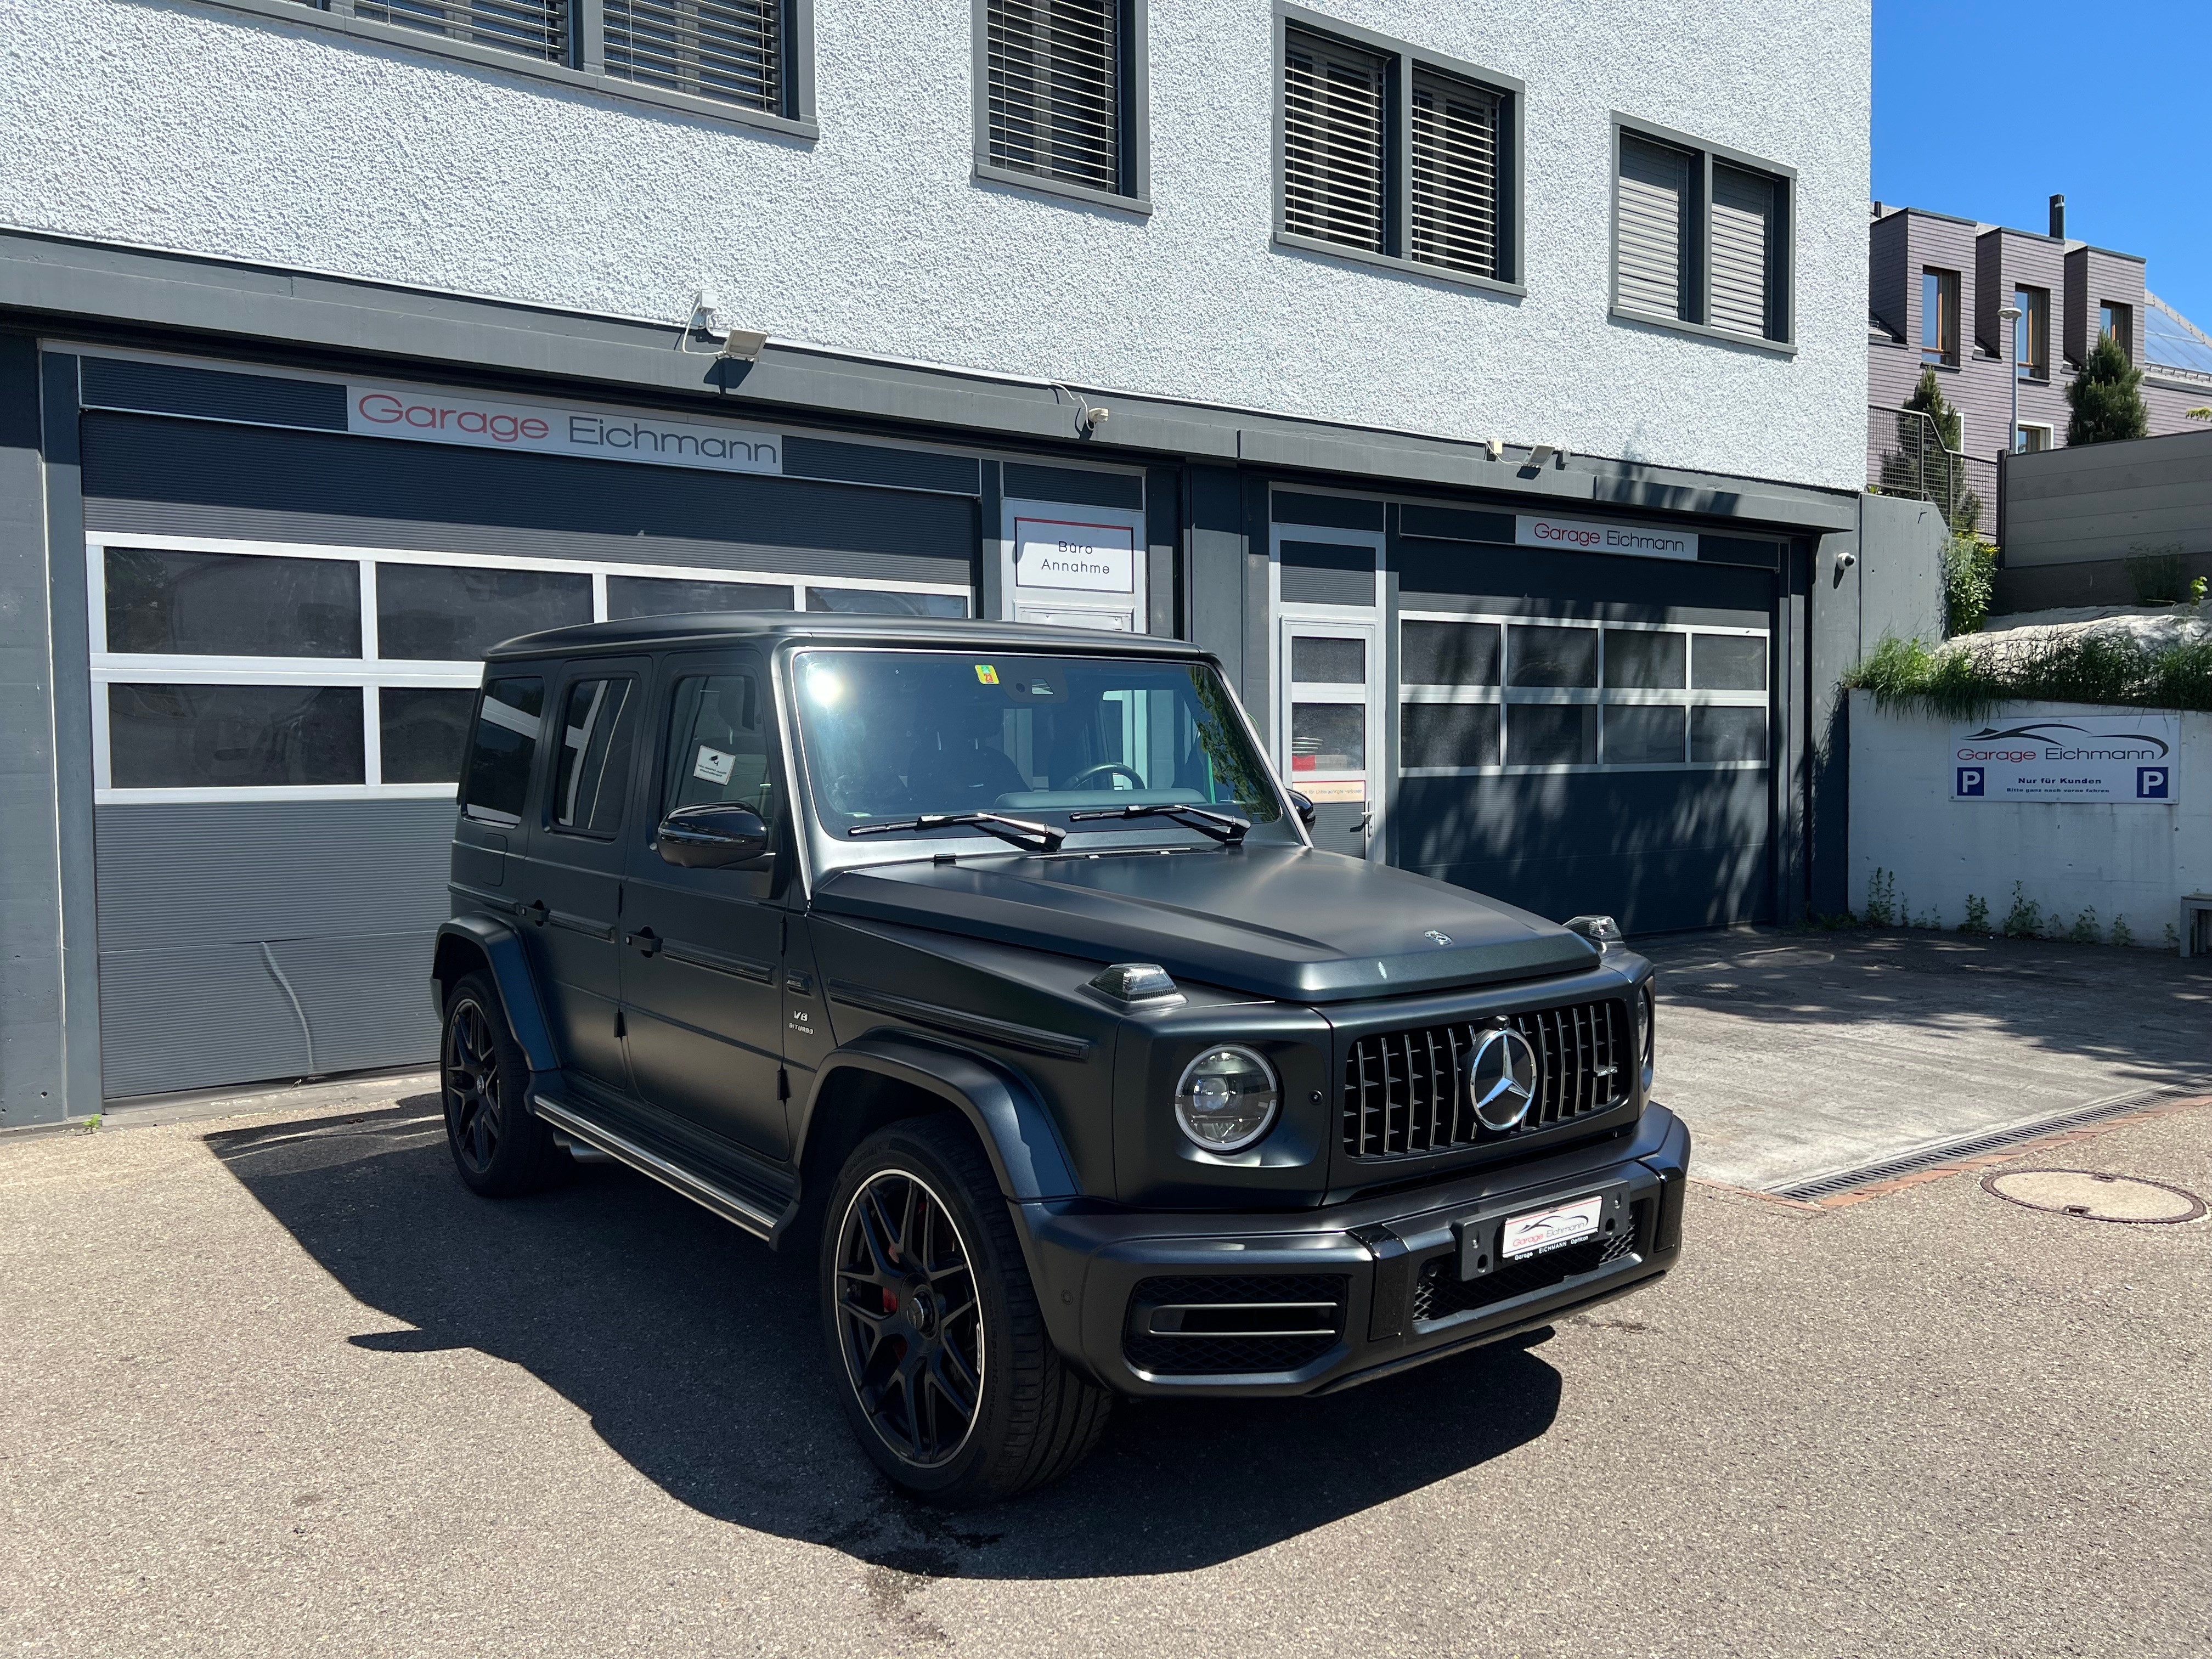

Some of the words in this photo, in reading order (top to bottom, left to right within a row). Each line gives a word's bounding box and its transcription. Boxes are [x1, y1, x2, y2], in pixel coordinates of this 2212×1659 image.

[359, 394, 550, 443] Garage
[569, 415, 777, 464] Eichmann
[1534, 523, 1600, 546] Garage
[1606, 530, 1684, 552] Eichmann
[1058, 540, 1093, 555] Büro
[1041, 558, 1110, 574] Annahme
[984, 673, 994, 682] 23
[1957, 748, 2036, 763] Garage
[2046, 747, 2155, 760] Eichmann
[794, 1011, 808, 1021] V8
[789, 1023, 814, 1034] BITURBO
[1513, 1234, 1543, 1246] Garage
[1547, 1222, 1584, 1237] Eichmann
[1515, 1252, 1533, 1260] Garage
[1539, 1242, 1567, 1254] EICHMANN
